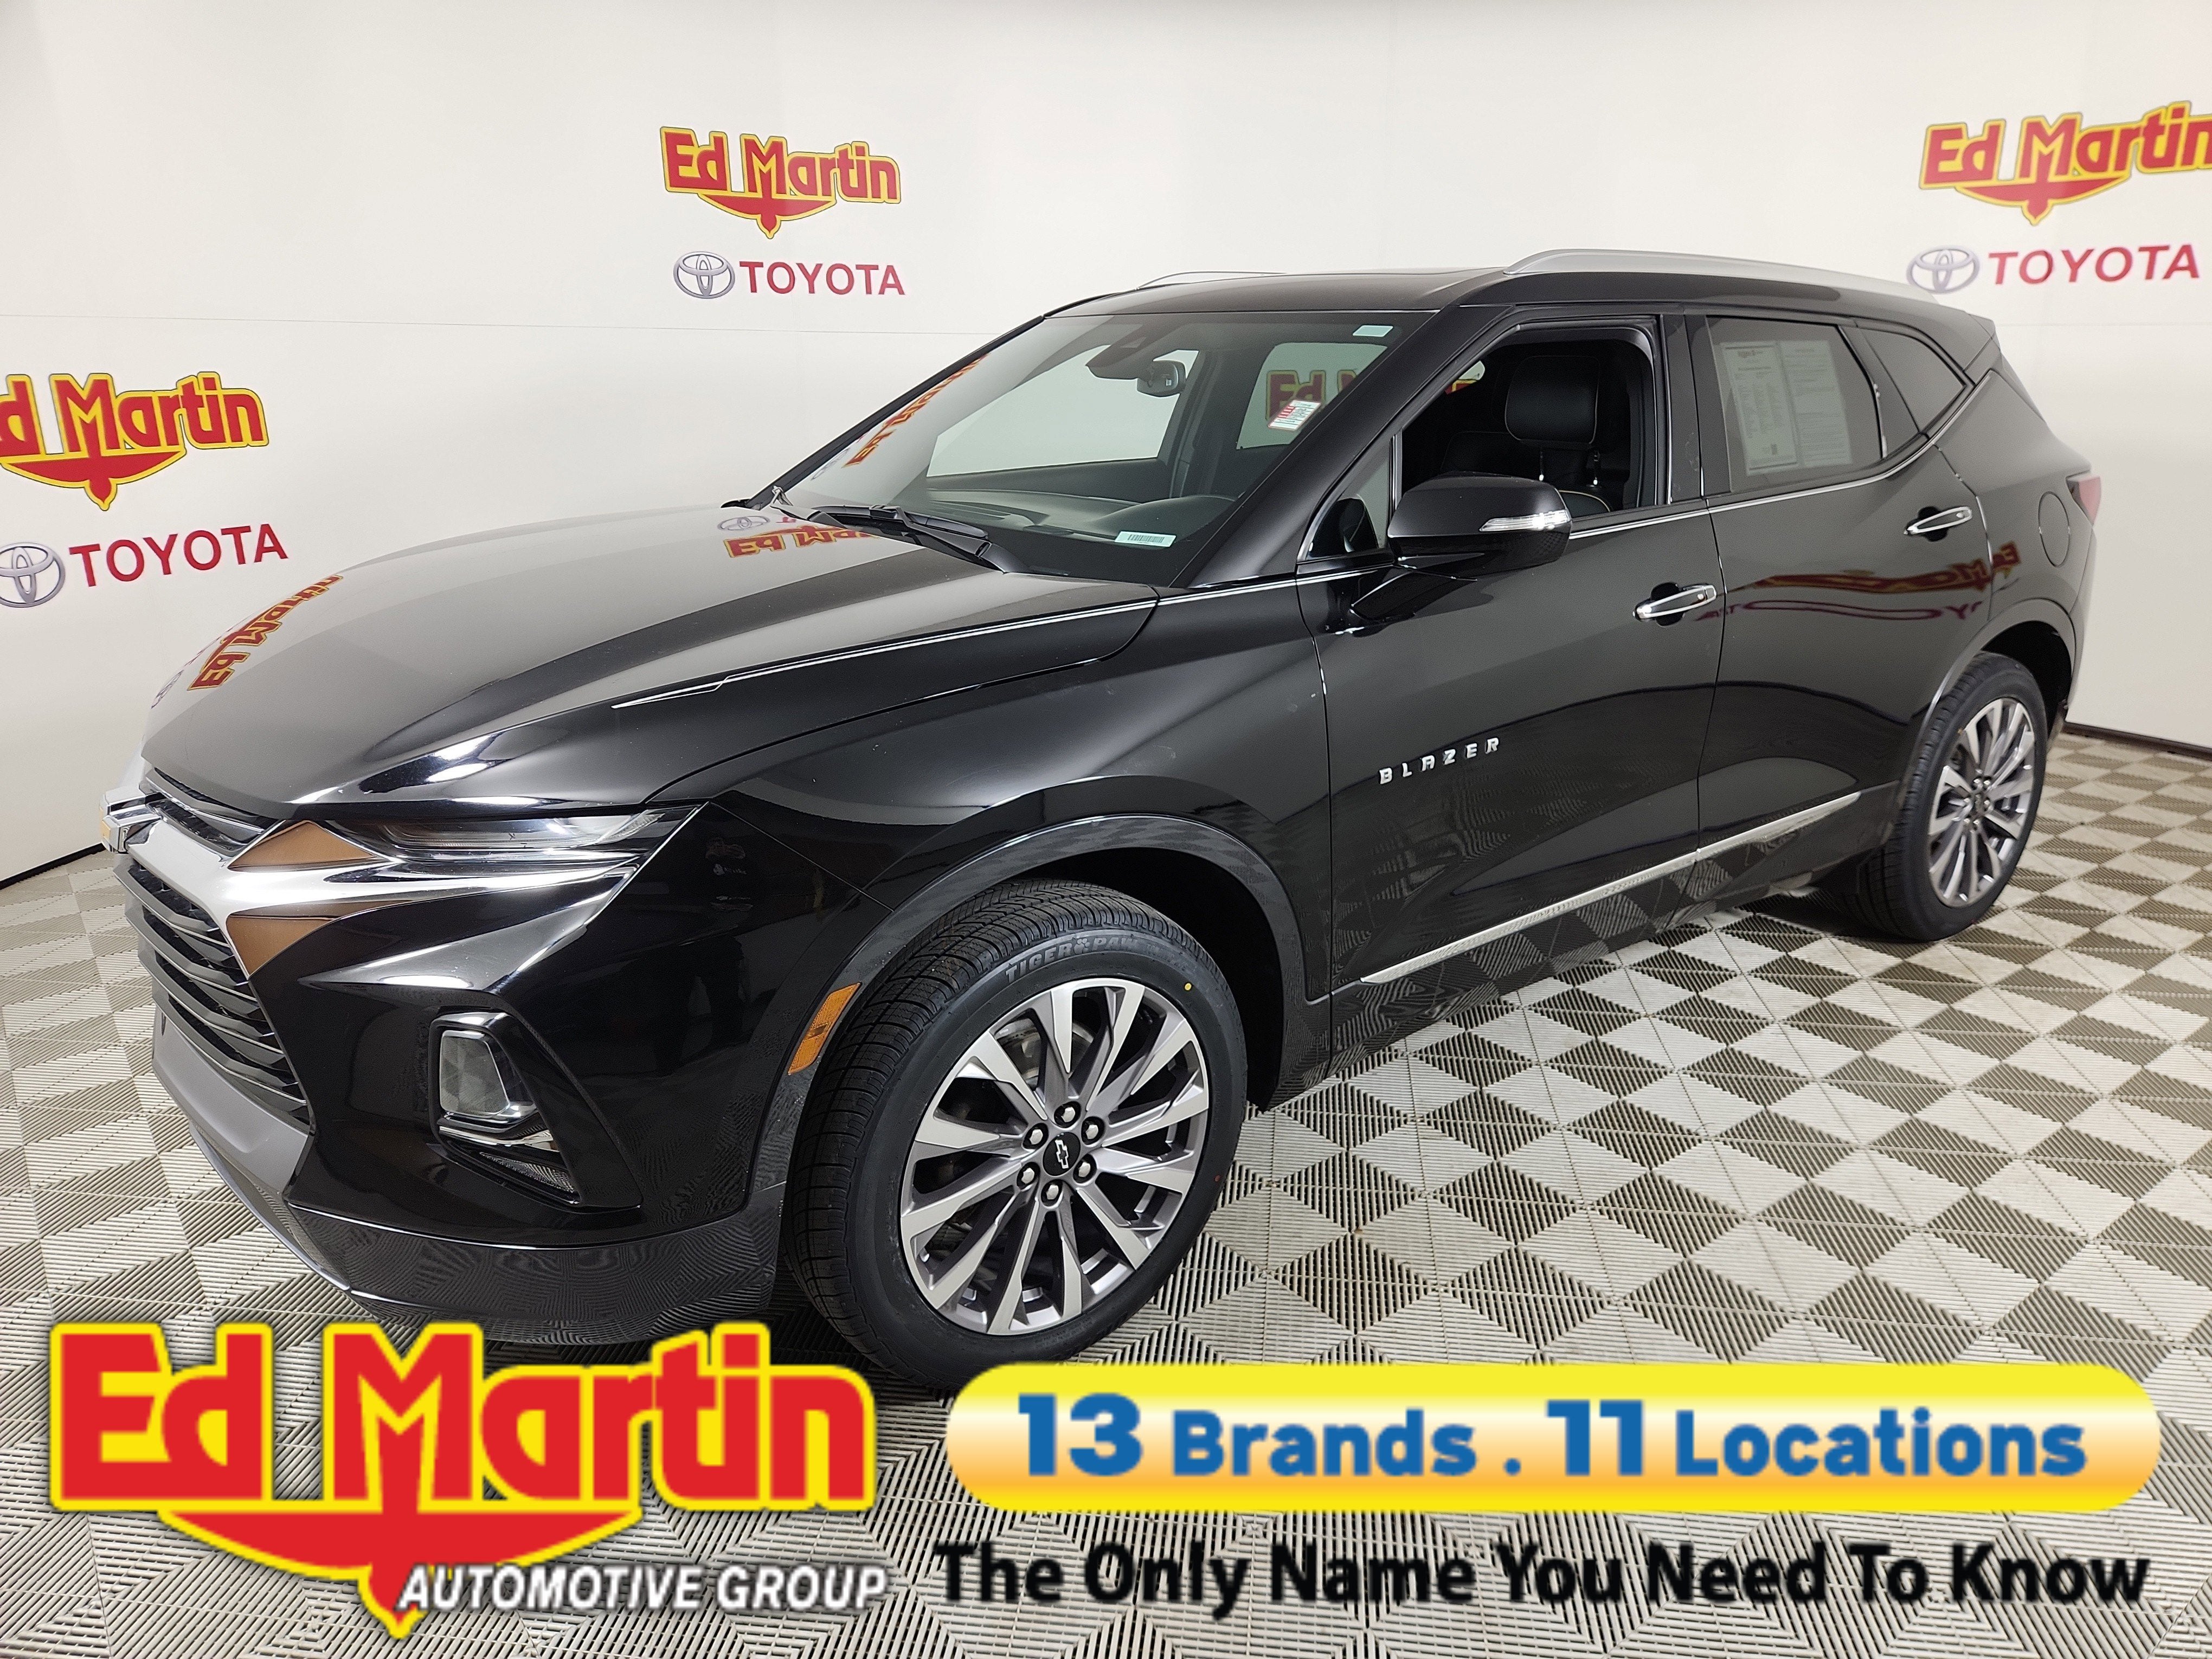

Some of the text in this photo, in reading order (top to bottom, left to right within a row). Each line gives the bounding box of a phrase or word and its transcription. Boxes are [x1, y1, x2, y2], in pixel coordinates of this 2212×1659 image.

[661, 127, 901, 203] Ed Martin
[1921, 101, 2212, 188] Ed Martin
[739, 260, 905, 295] TOYOTA
[1988, 243, 2200, 285] TOYOTA
[0, 372, 268, 457] d Martin
[69, 523, 289, 587] TOYOTA
[1379, 737, 1499, 785] BLAZER
[1005, 936, 1140, 983] TIGER PAW
